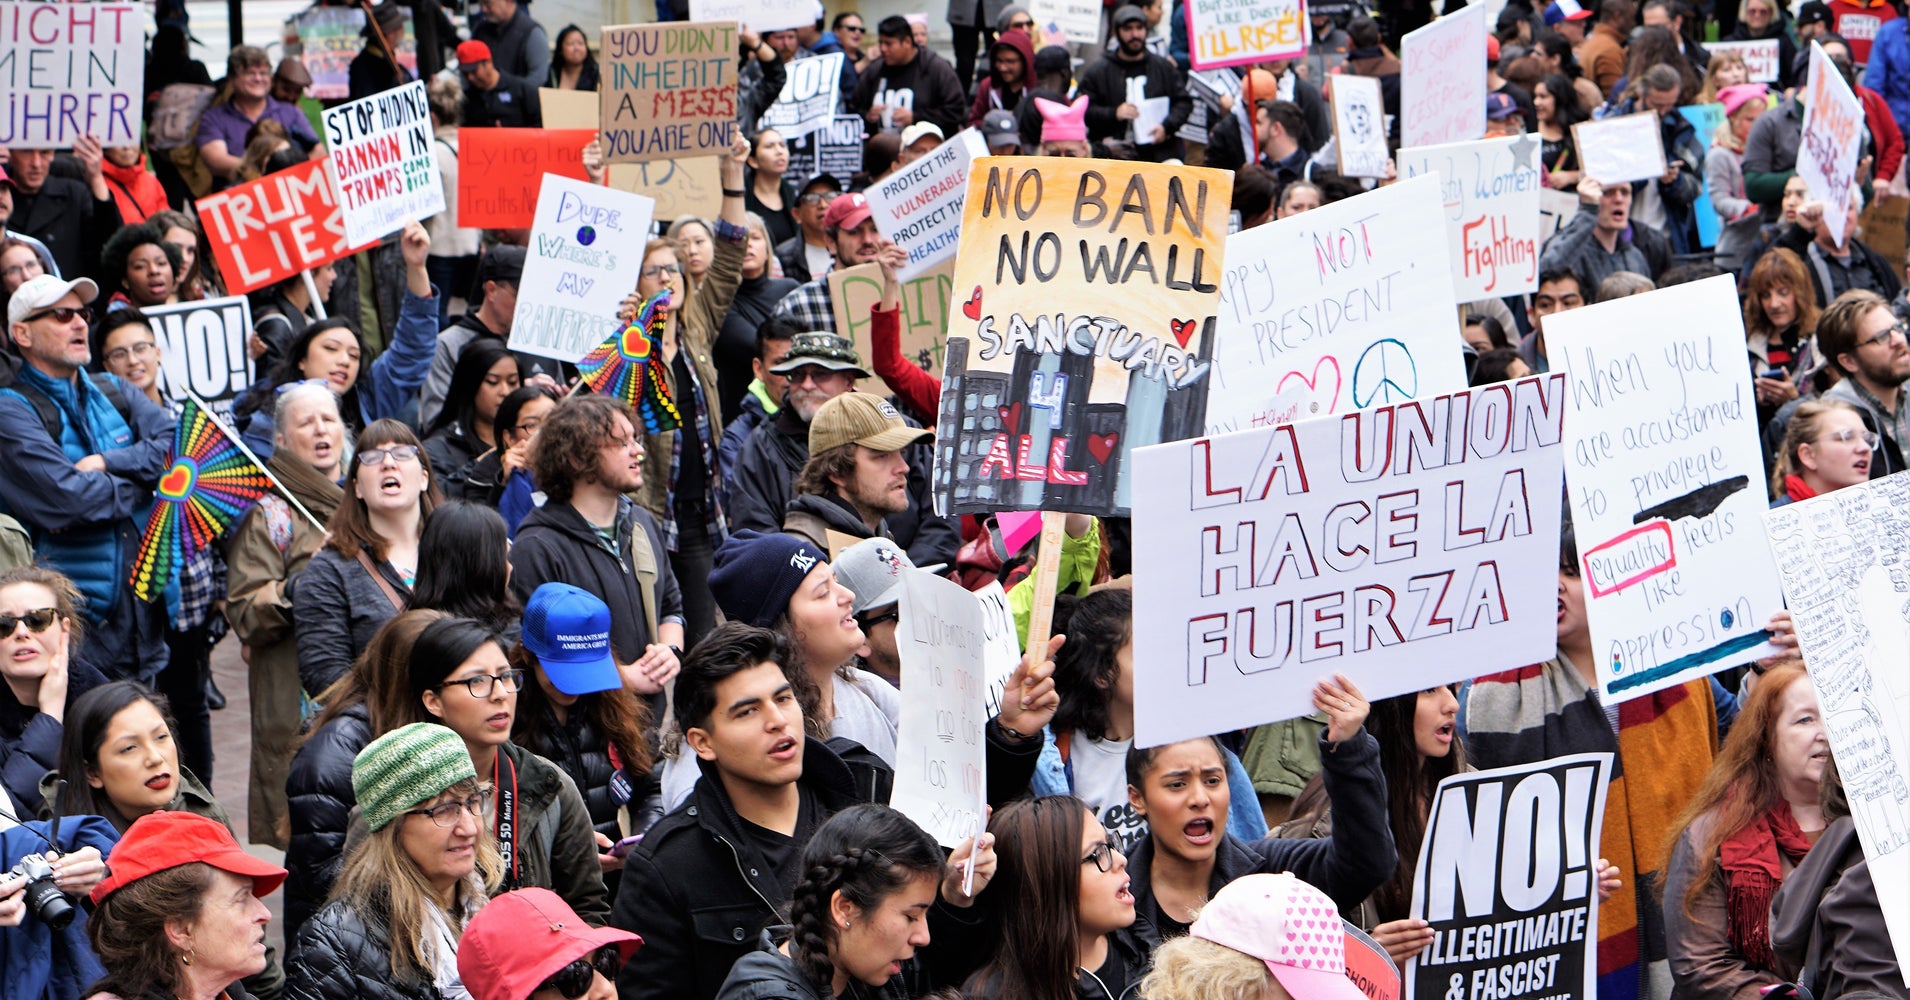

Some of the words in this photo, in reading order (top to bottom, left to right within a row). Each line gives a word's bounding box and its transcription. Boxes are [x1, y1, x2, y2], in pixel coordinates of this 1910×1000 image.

[0, 5, 133, 44] ICHT
[611, 30, 659, 59] YOU
[665, 26, 736, 55] DIDN'T
[1216, 10, 1242, 24] LIKE
[609, 57, 731, 90] INHERIT
[327, 101, 374, 145] STOP
[378, 84, 426, 130] HIDING
[614, 92, 638, 121] A
[652, 83, 737, 119] MESS
[334, 131, 402, 181] BANNON
[408, 125, 429, 156] IN
[465, 136, 538, 177] Lying
[604, 128, 645, 158] YOU
[646, 123, 693, 154] ARE
[697, 120, 738, 148] ONE
[882, 160, 935, 201] PROTECT
[934, 146, 957, 169] THE
[890, 167, 967, 221] VULNERABLE
[1409, 156, 1465, 222] sty
[1474, 151, 1539, 200] Women
[892, 205, 947, 247] PROTECT
[981, 165, 1043, 221] NO
[1072, 169, 1208, 239] BAN
[230, 204, 347, 287] LIES
[538, 232, 618, 272] WHERE'S
[994, 229, 1063, 287] NO
[1079, 237, 1218, 294] WALL
[1218, 257, 1275, 324] PPY
[1313, 212, 1380, 287] NOT
[1462, 213, 1537, 293] Fighting
[556, 271, 595, 298] MY
[1252, 270, 1402, 366] PRESIDENT
[148, 304, 248, 401] NO!
[976, 312, 1210, 392] SANCTUARY
[1563, 346, 1650, 412] When
[1664, 336, 1721, 406] you
[1028, 370, 1070, 430] 4
[1575, 431, 1614, 469] are
[1622, 382, 1744, 451] accustomed
[978, 432, 1090, 486] ALL
[1190, 423, 1310, 511] LA
[1340, 372, 1566, 484] UNION
[1580, 486, 1607, 523] to
[1200, 488, 1420, 599] HACE
[1443, 467, 1533, 552] LA
[1591, 534, 1669, 597] equality
[1681, 511, 1735, 556] feels
[1641, 570, 1689, 614] like
[556, 633, 598, 642] IMMIGRANTS
[561, 642, 593, 650] AMERICA
[1187, 558, 1510, 687] FUERZA
[935, 708, 956, 736] no
[922, 746, 948, 789] los
[501, 823, 512, 839] 5D
[503, 801, 513, 821] Mark
[1428, 765, 1595, 923] NO!
[1420, 906, 1587, 967] ILLEGITIMATE
[1344, 966, 1378, 998] SHOW
[1444, 973, 1465, 1000] &
[1470, 953, 1561, 1000] FASCIST
